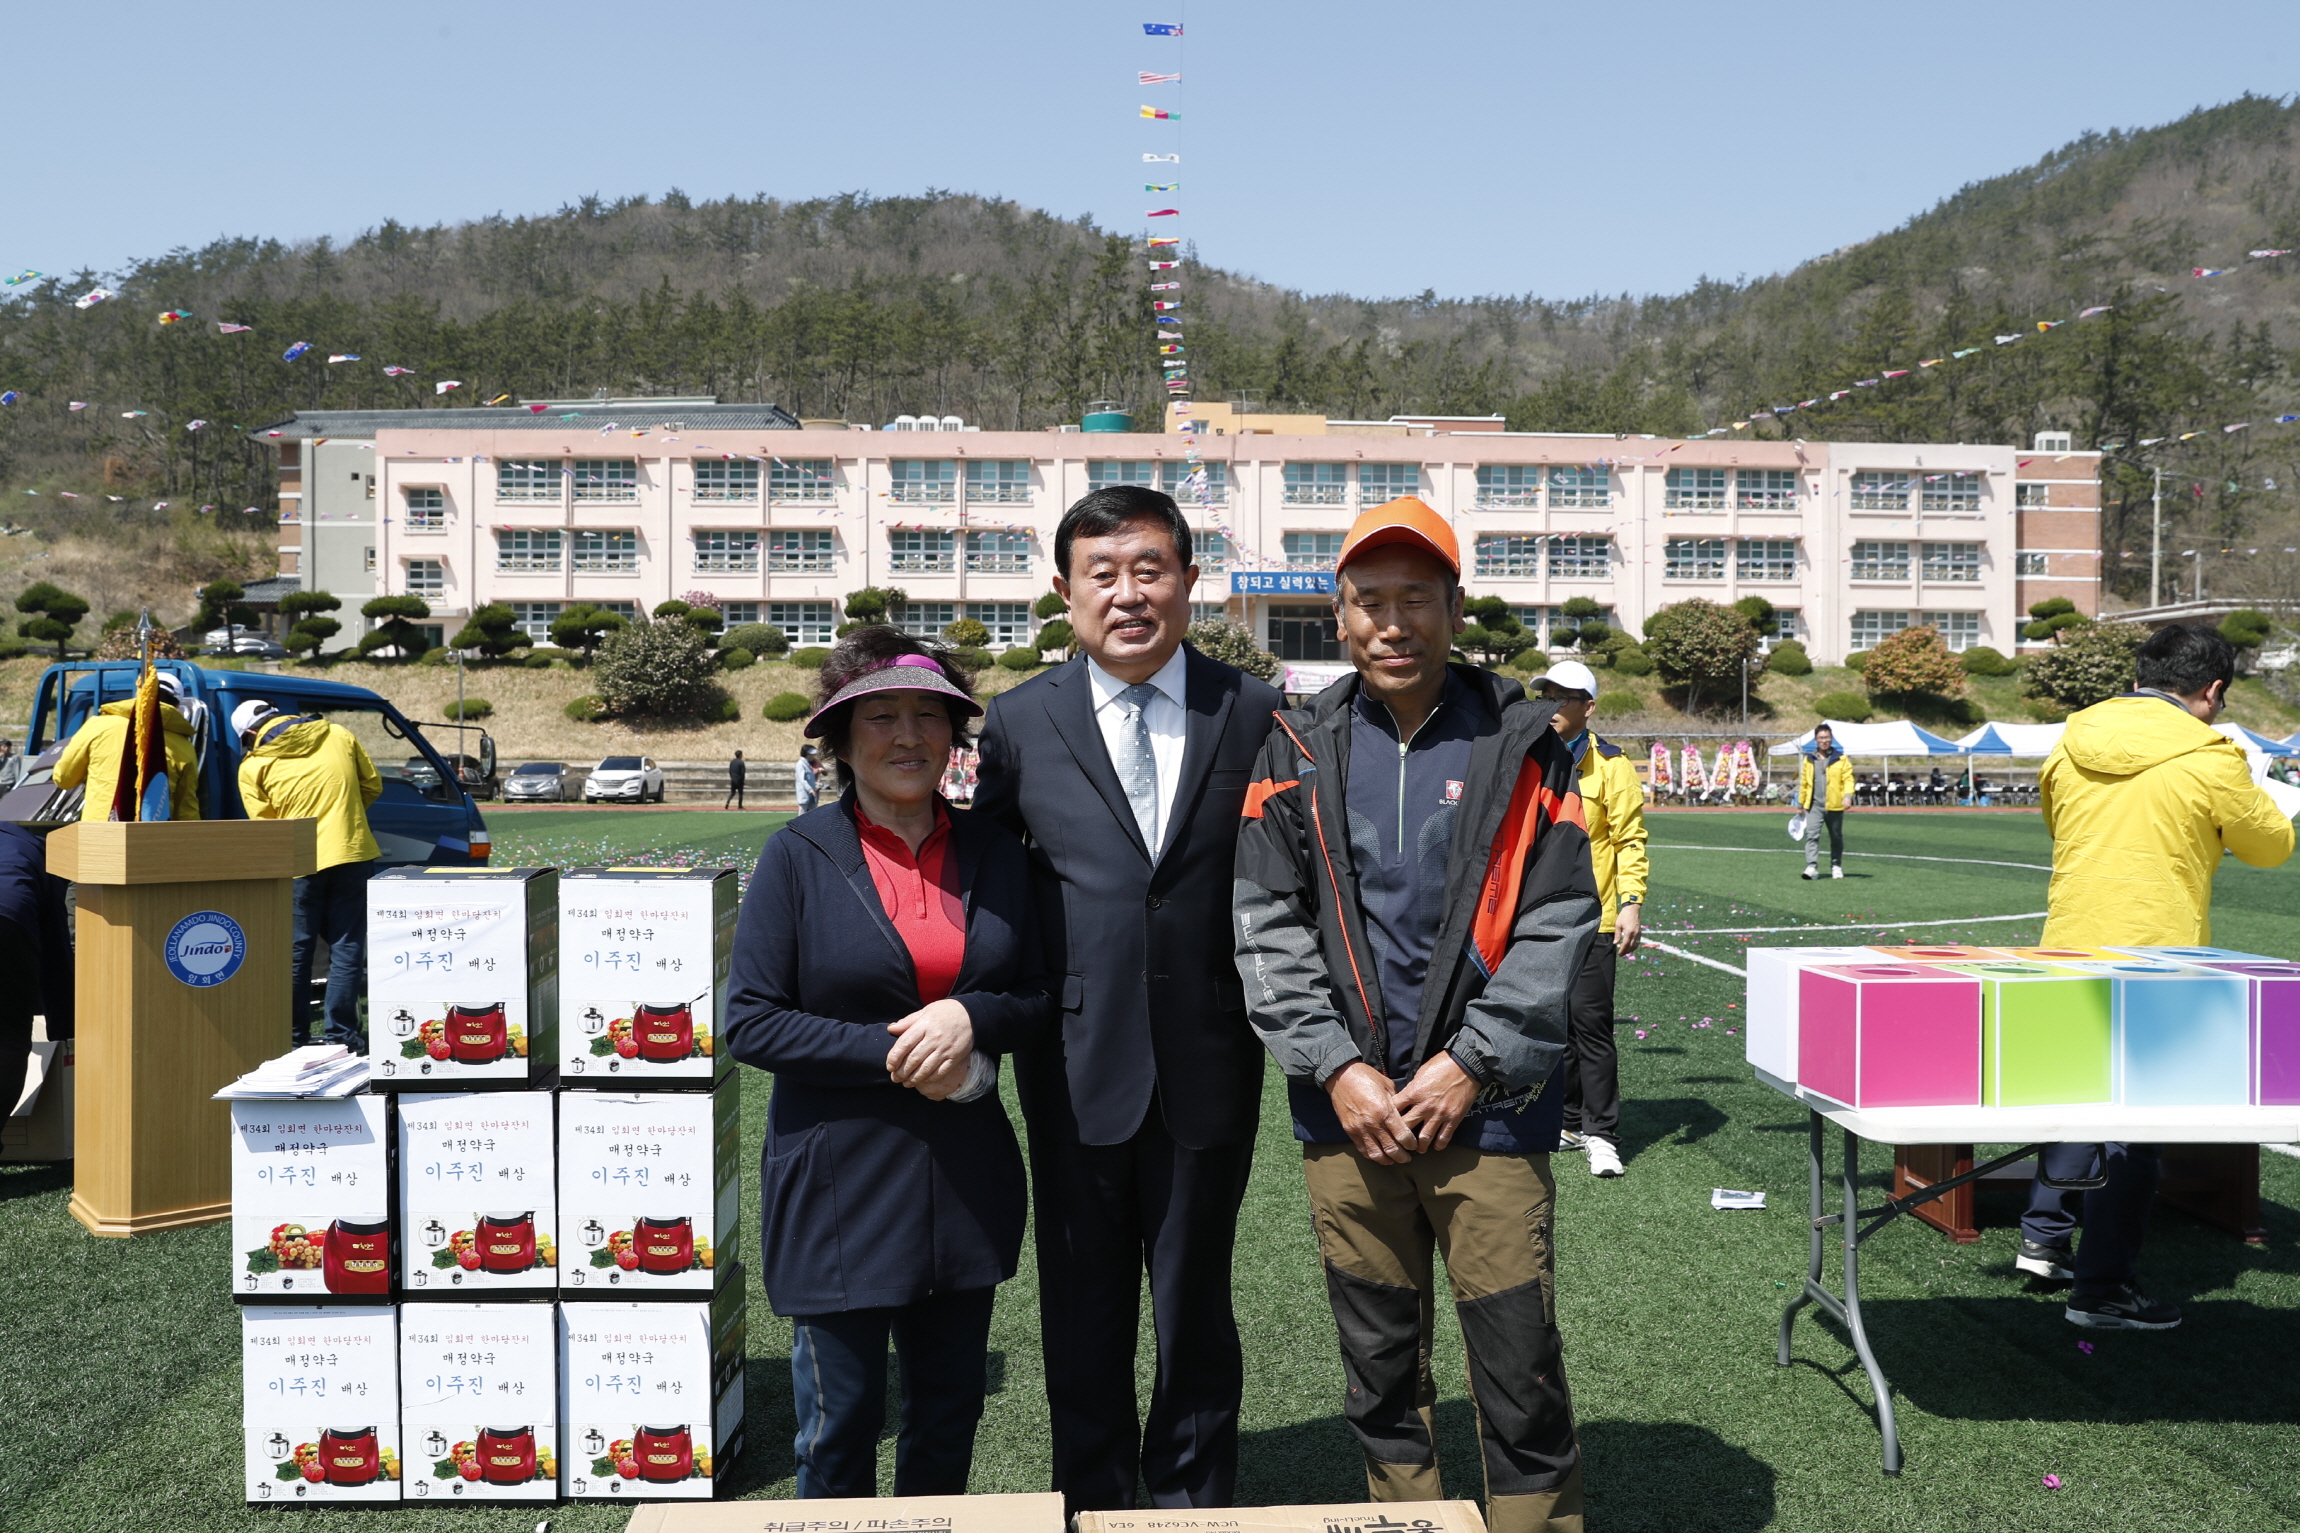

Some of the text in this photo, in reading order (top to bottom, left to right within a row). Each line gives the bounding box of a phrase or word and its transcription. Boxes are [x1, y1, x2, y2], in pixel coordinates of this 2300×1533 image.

[1236, 575, 1330, 590] 참되고 실력있는
[1438, 798, 1460, 806] BLACK
[376, 909, 501, 922] 제34회 임회면 한마당잔치
[567, 908, 598, 918] 제34회
[604, 909, 633, 920] 임회면
[640, 910, 688, 921] 한마당잔치
[168, 914, 243, 963] JEOLLANAMDO JINDO COUNTY
[410, 927, 467, 942] 매정약국
[601, 927, 655, 942] 매정약국
[179, 944, 224, 958] Jindo
[393, 951, 497, 972] 이주진 배상
[583, 950, 683, 973] 이주진 배상
[238, 1122, 363, 1135] 제34회 임회면 한마당잔치
[407, 1120, 529, 1131] 제34회 임회면 한마당잔치
[574, 1124, 696, 1136] 제34회 임회면 한마당잔치
[274, 1141, 329, 1157] 매정약국
[441, 1138, 496, 1153] 매정약국
[608, 1143, 663, 1158] 매정약국
[257, 1165, 359, 1187] 이주진 배상
[425, 1161, 526, 1183] 이주진 배상
[591, 1166, 692, 1188] 이주진 배상
[250, 1335, 371, 1346] 제34회 임회면 한마당잔치
[408, 1333, 529, 1345] 제34회 임회면 한마당잔치
[567, 1331, 687, 1344] 제34회 임회면 한마당잔치
[284, 1353, 339, 1368] 매정약국
[442, 1351, 496, 1366] 매정약국
[601, 1351, 654, 1366] 매정약국
[268, 1376, 369, 1398] 이주진 배상
[425, 1373, 525, 1396] 이주진 배상
[585, 1374, 683, 1395] 이주진 배상
[763, 1520, 849, 1533] 취급주의
[867, 1516, 953, 1530] 파손주의
[1108, 1520, 1239, 1529] UCW-VC6248 6EA
